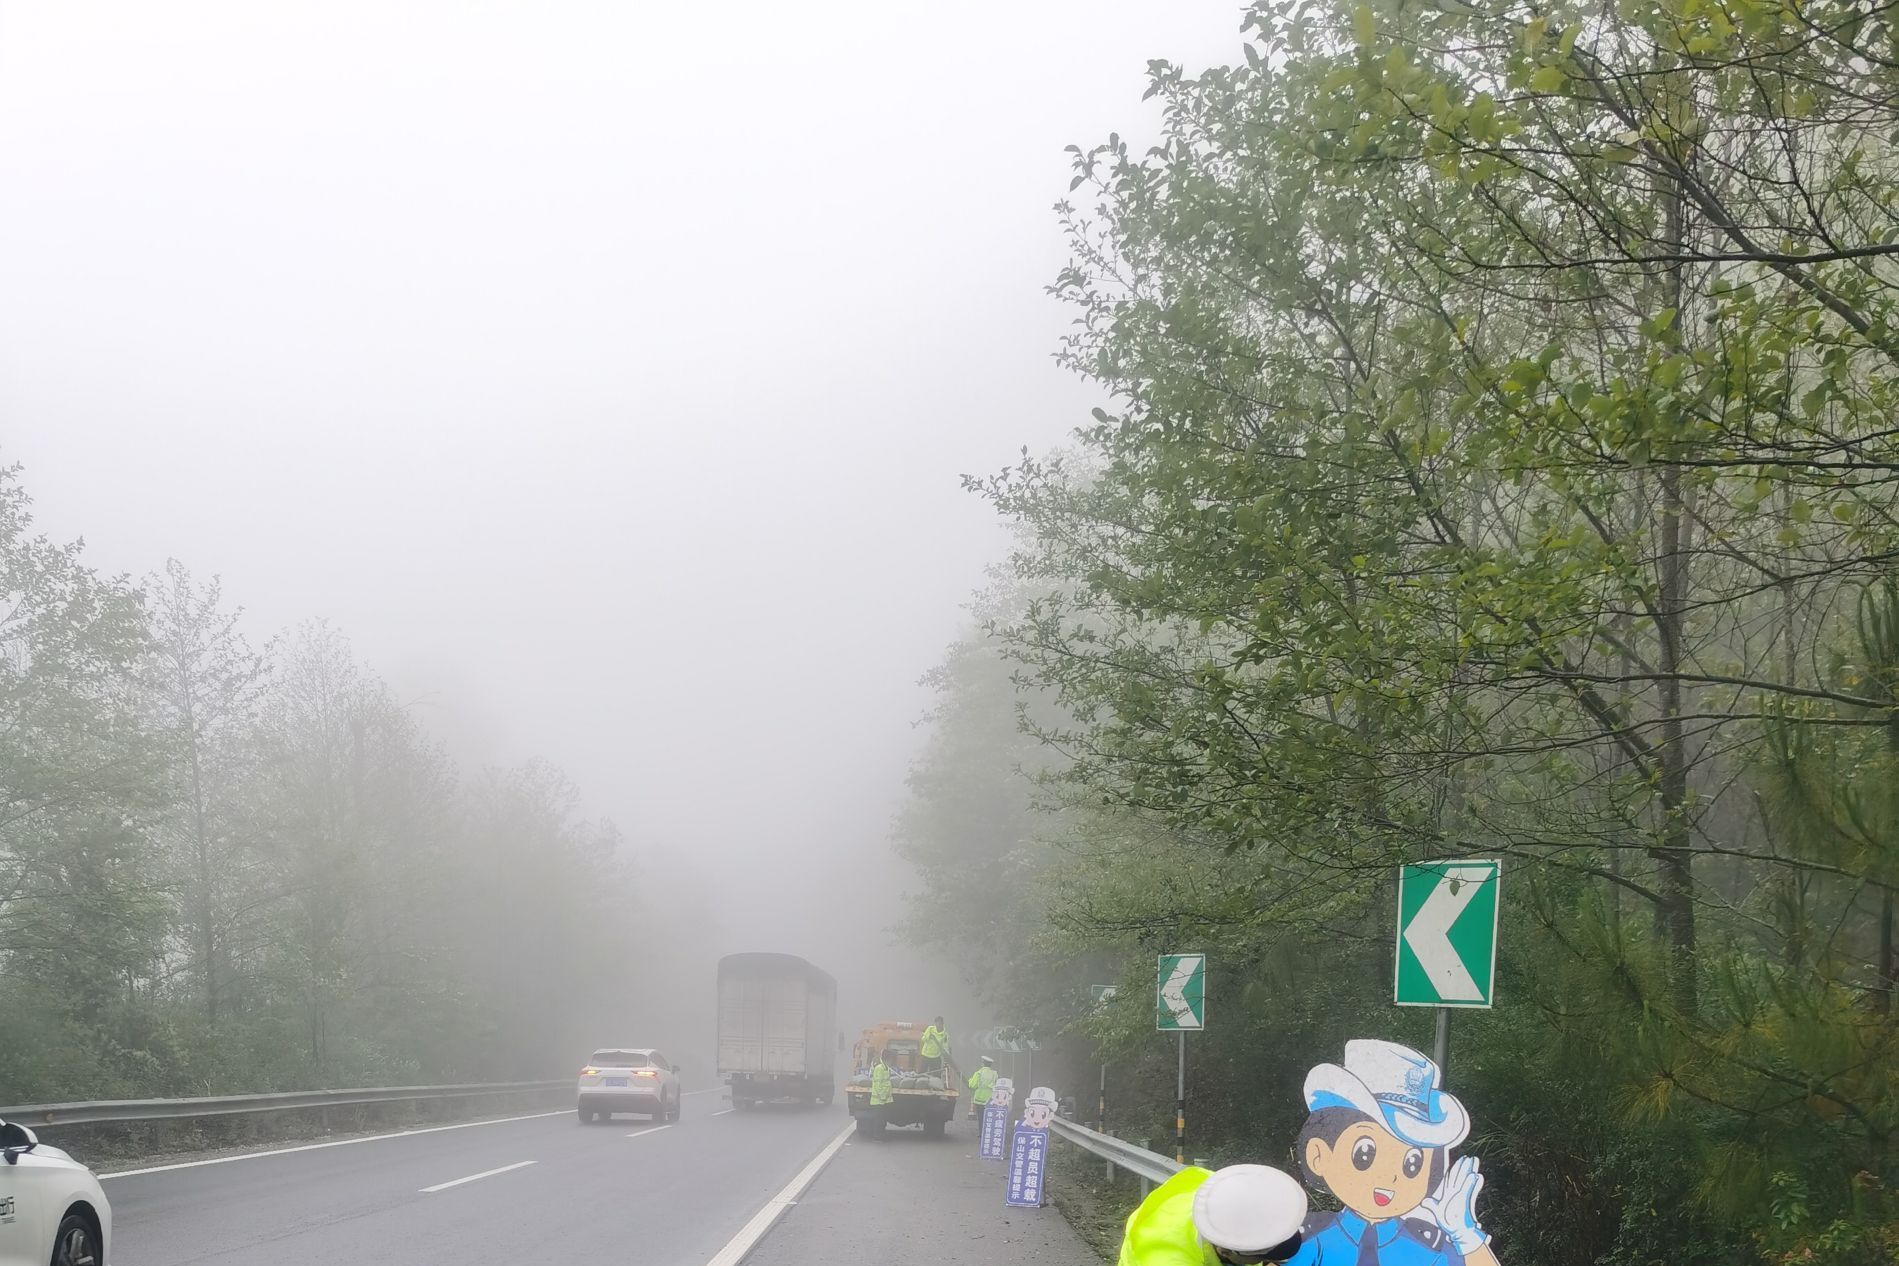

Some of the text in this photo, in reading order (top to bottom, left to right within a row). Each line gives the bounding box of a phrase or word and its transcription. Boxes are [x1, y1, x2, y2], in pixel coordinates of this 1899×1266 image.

[1024, 1135, 1042, 1201] 不超员超载
